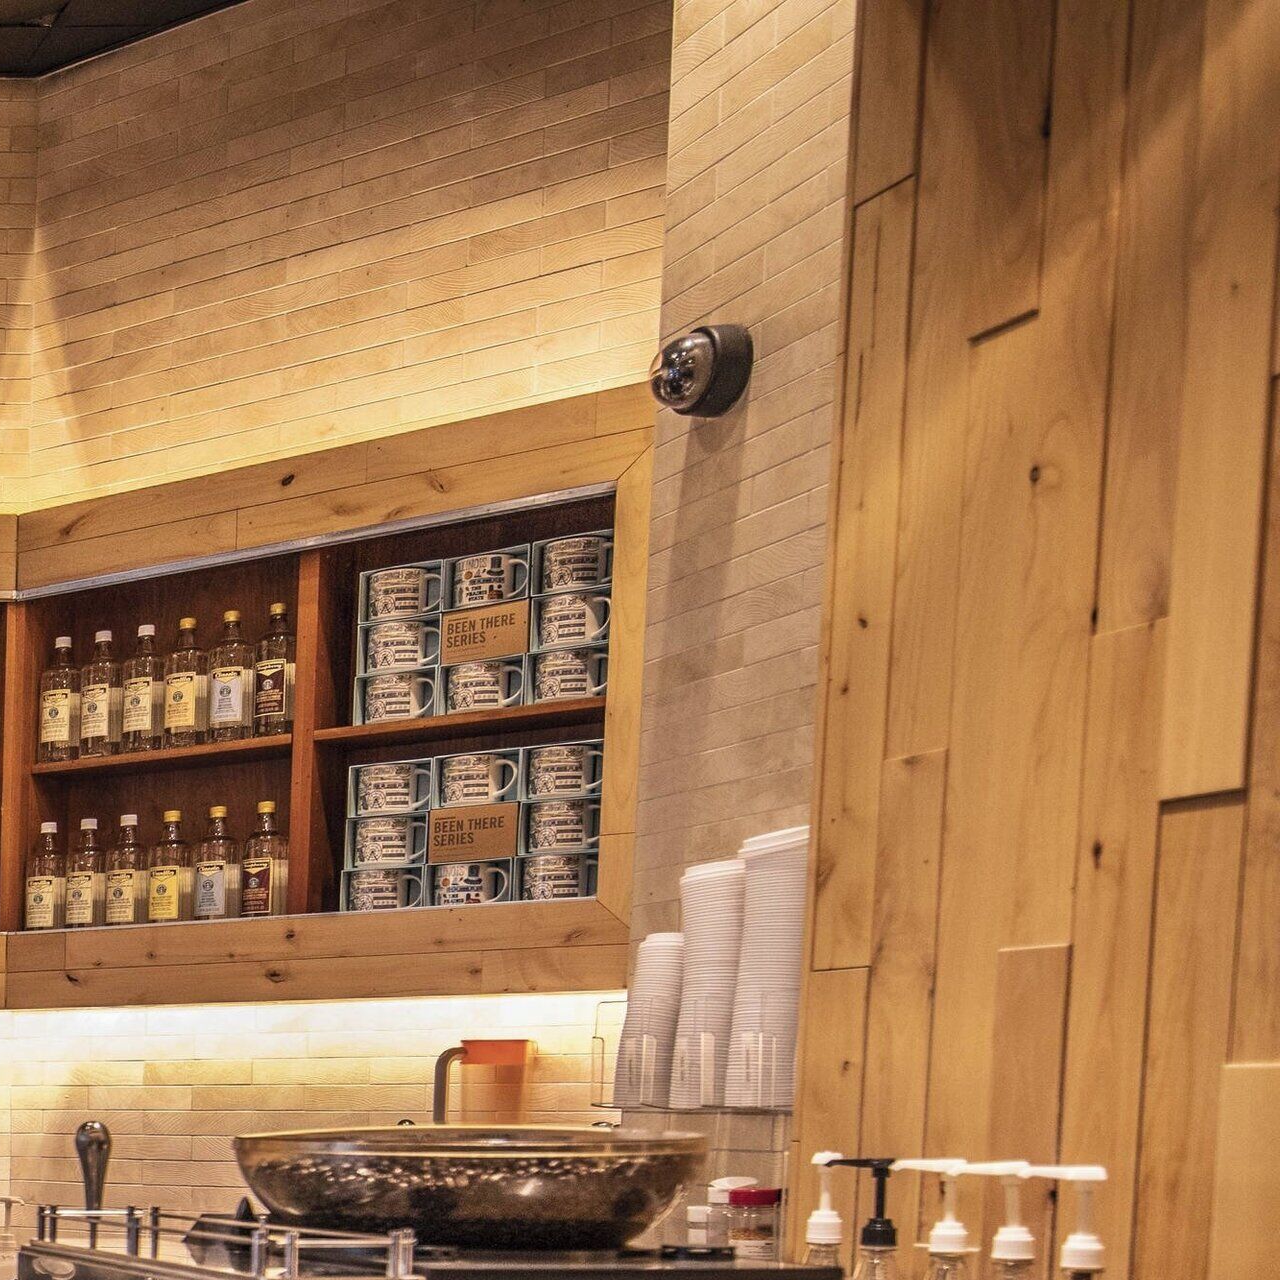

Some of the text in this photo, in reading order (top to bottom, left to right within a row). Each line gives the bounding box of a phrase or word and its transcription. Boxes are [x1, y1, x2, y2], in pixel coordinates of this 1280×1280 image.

[447, 613, 516, 635] BEEN THERE
[446, 631, 486, 648] SERIES
[434, 816, 504, 834] BEEN THERE
[433, 833, 474, 847] SERIES
